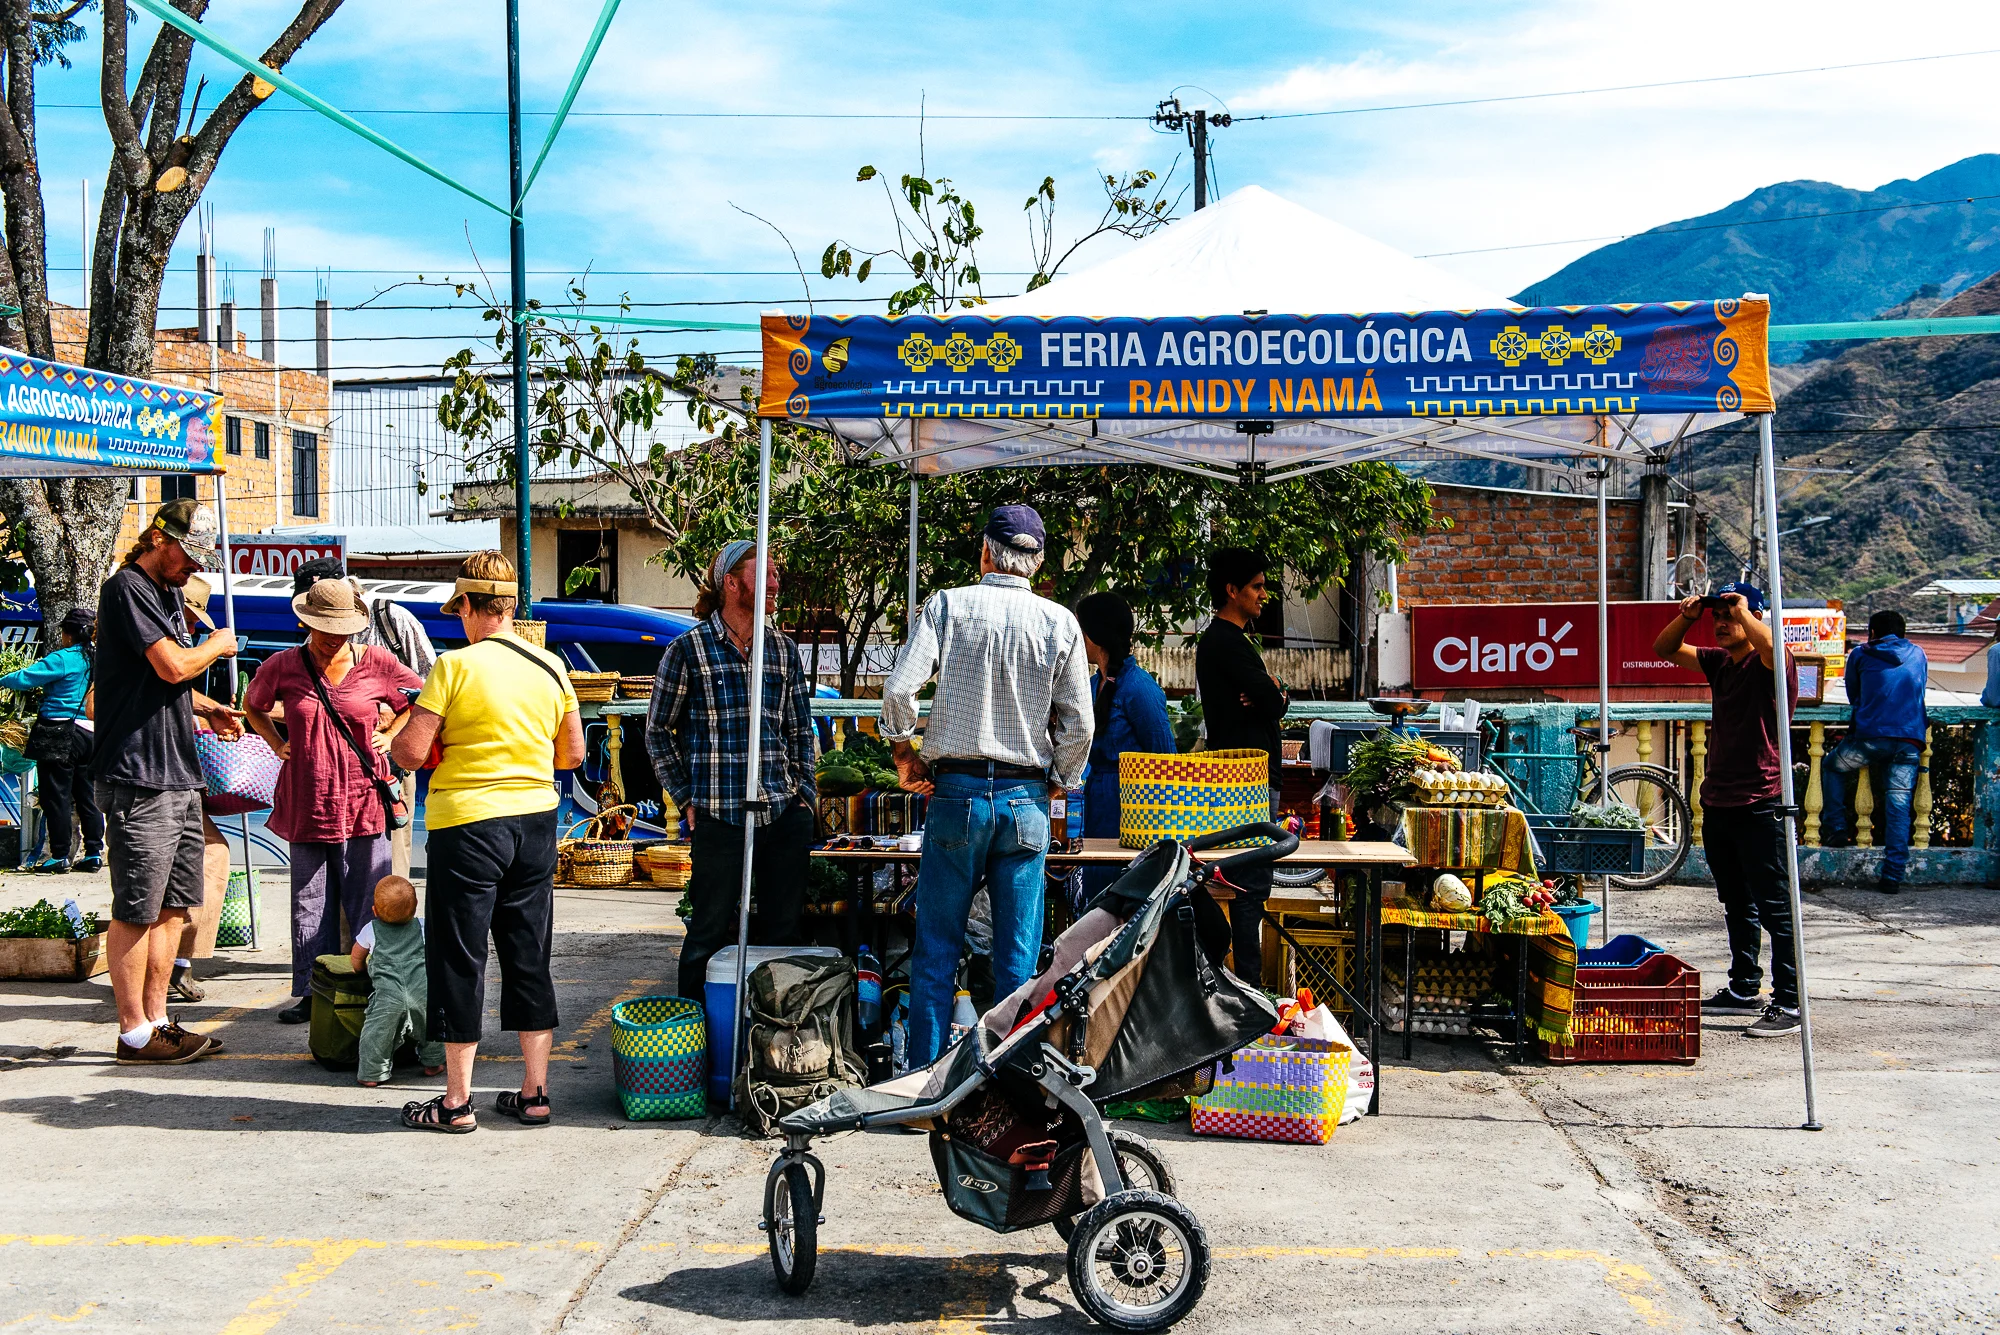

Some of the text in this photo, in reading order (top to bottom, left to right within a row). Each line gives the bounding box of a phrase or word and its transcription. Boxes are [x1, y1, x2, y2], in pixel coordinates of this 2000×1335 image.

[1041, 320, 1473, 367] FERIA AGROECOLÓGICA
[8, 383, 133, 431] AGROECOLÓGICA
[1128, 368, 1384, 414] RANDY NAMÁ
[0, 421, 104, 462] RANDY NAMÁ
[1433, 636, 1555, 673] Claro
